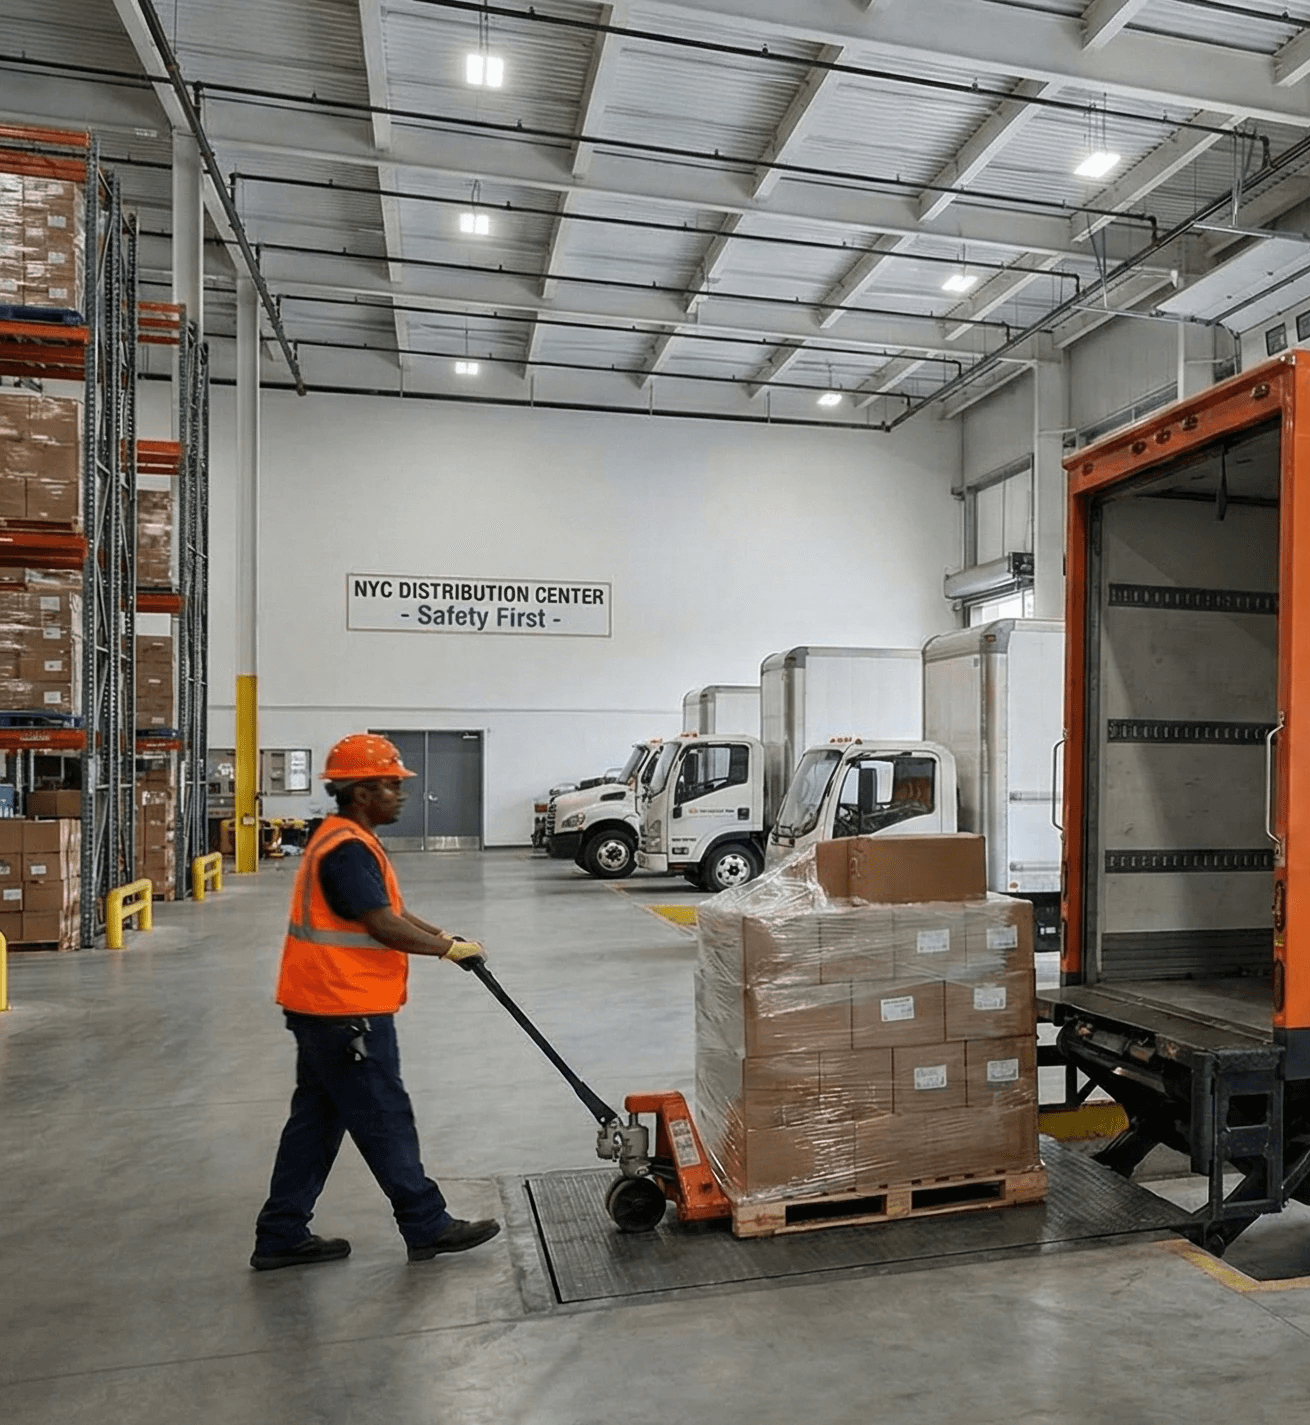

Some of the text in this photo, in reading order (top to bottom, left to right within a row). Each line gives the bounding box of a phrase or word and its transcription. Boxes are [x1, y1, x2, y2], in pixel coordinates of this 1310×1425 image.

[354, 580, 604, 605] NYC DISTRIBUTION CENTER
[417, 605, 489, 631] Safety
[497, 607, 546, 628] First
